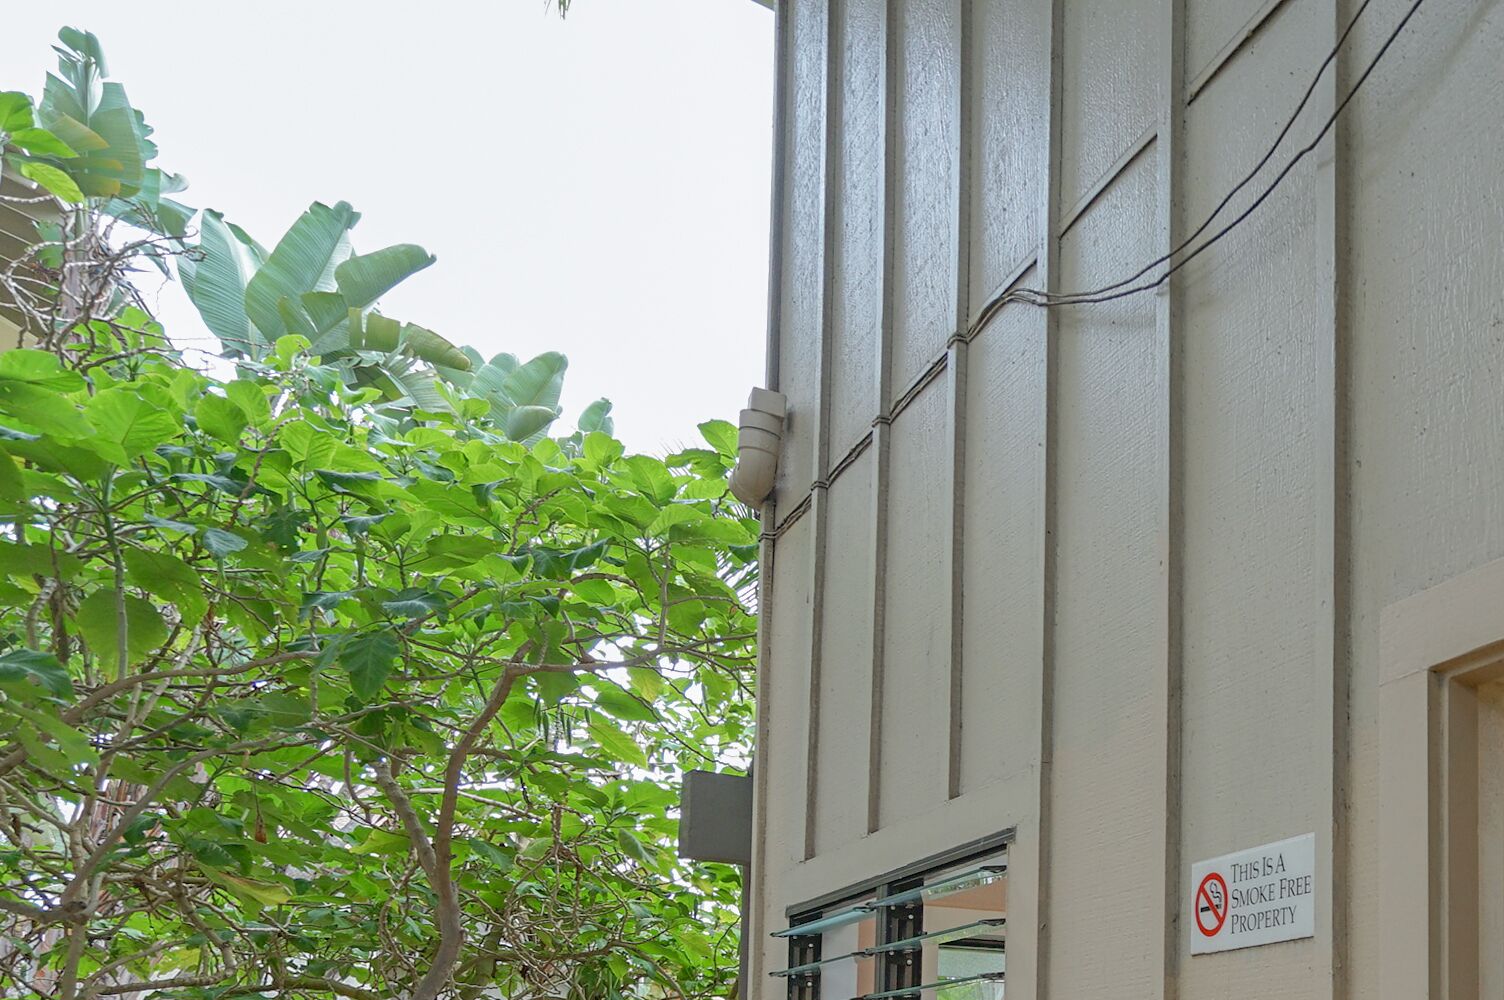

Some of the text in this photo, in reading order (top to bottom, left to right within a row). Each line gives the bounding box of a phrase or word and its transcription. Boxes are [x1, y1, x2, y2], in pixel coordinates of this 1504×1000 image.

[1230, 860, 1260, 883] THIS
[1275, 852, 1287, 873] A
[1231, 875, 1312, 909] SMOKE FREE
[1231, 905, 1297, 934] PROPERTY
